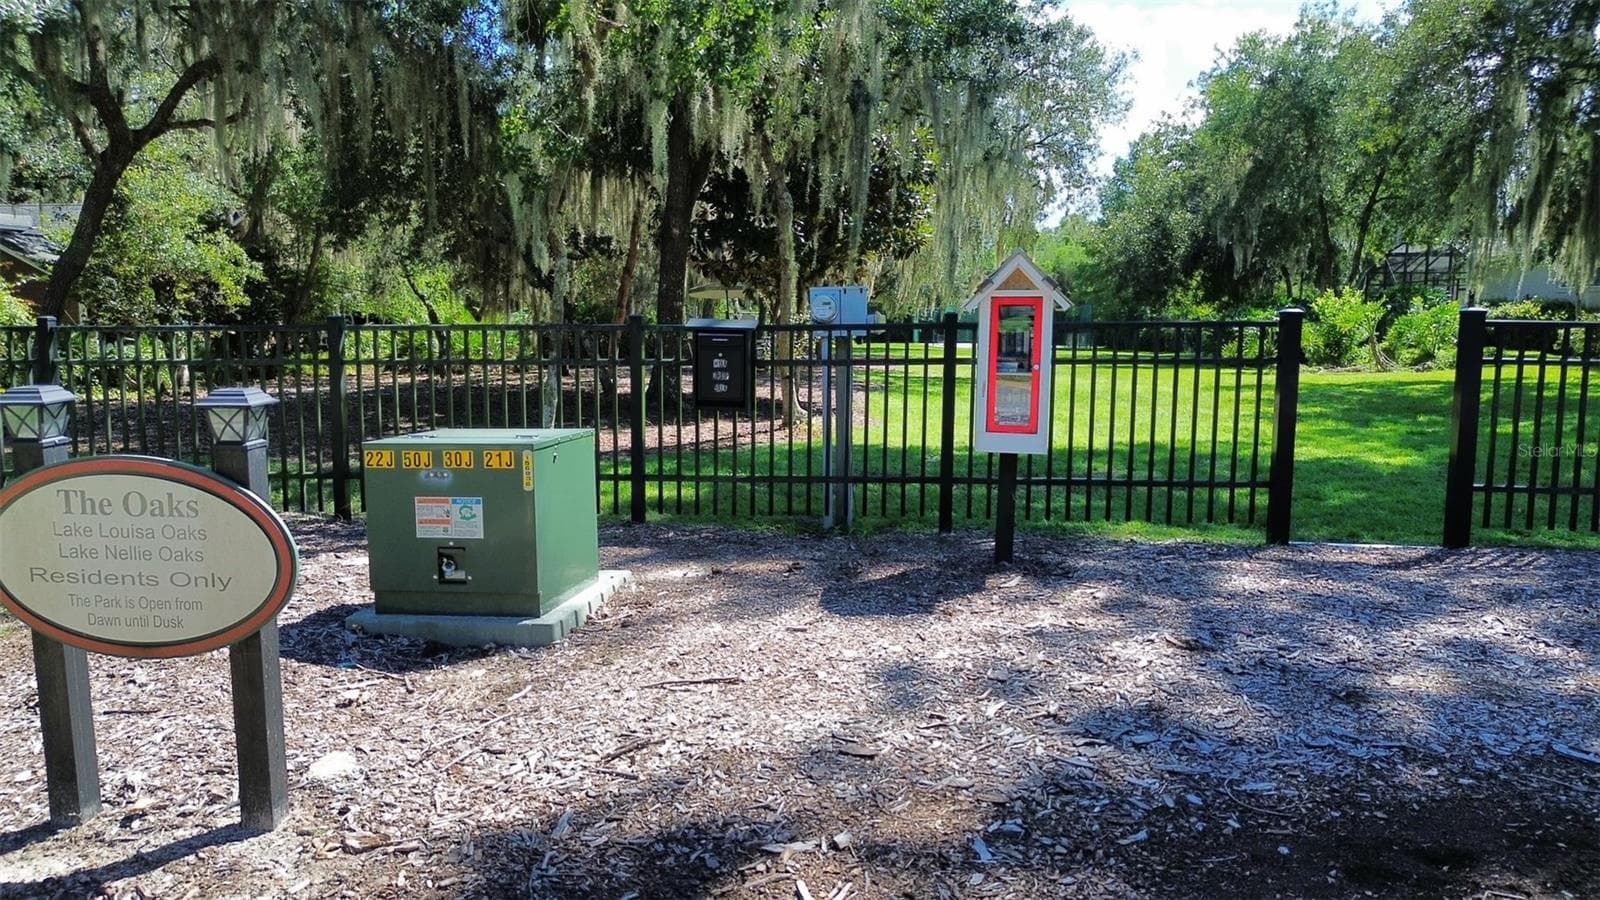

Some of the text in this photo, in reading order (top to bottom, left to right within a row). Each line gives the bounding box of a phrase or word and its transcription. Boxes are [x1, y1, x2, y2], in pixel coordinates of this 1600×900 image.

[366, 451, 394, 468] 22J
[403, 451, 432, 468] 50J
[444, 451, 473, 468] 30J
[485, 451, 513, 468] 21J
[56, 489, 200, 518] The Oaks
[53, 521, 208, 541] Lake Louisa Oaks
[59, 543, 205, 562] Lake Nellie Oaks
[29, 567, 233, 592] Residents Only
[68, 593, 203, 613] The Park is Open from
[87, 613, 184, 629] Dawn until Dusk
